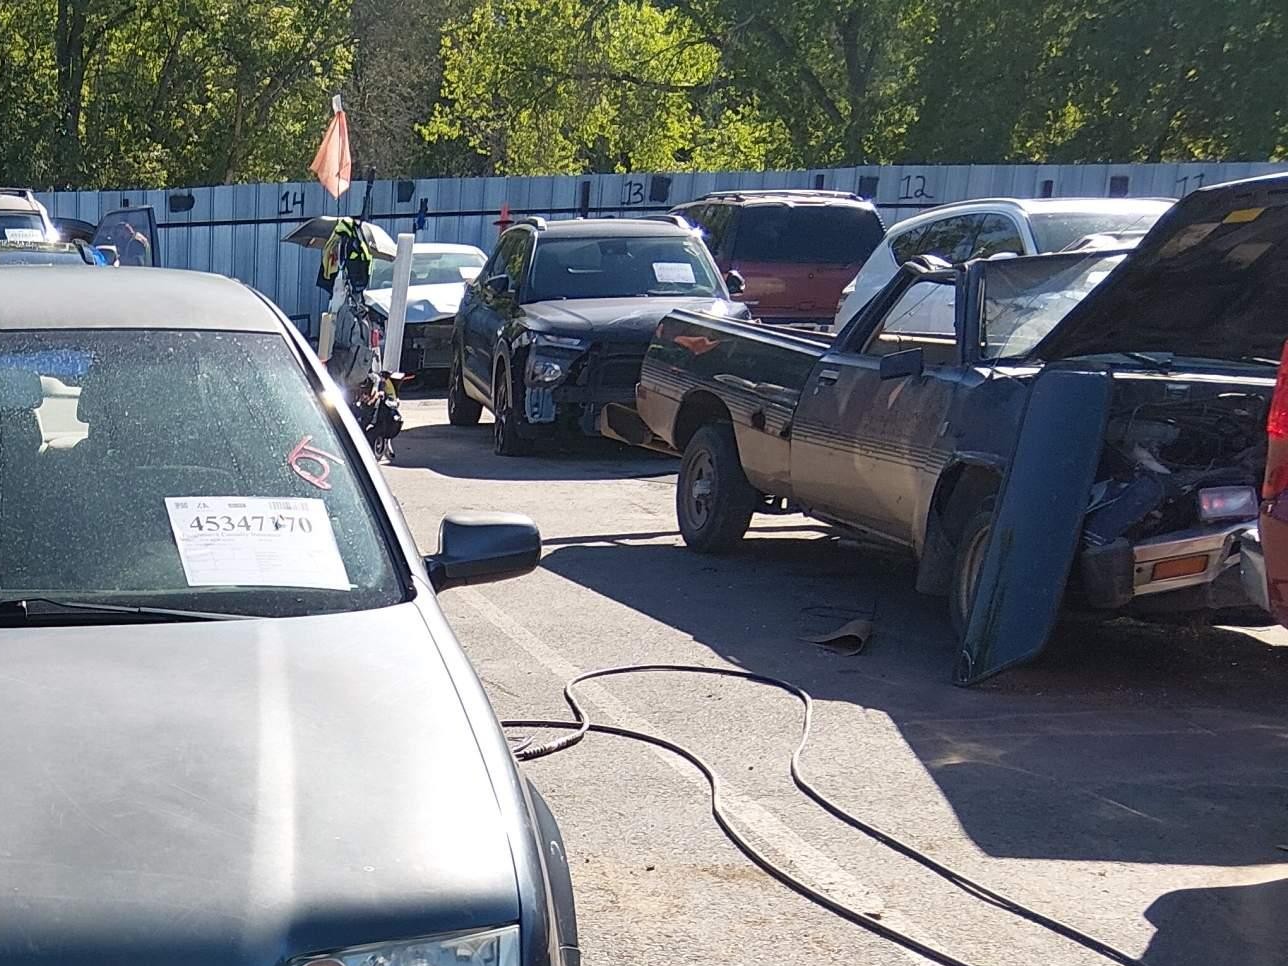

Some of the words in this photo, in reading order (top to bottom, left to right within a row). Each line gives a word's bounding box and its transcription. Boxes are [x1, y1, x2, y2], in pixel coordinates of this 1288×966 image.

[620, 180, 644, 206] 13
[898, 174, 935, 200] 12
[279, 189, 305, 217] 14
